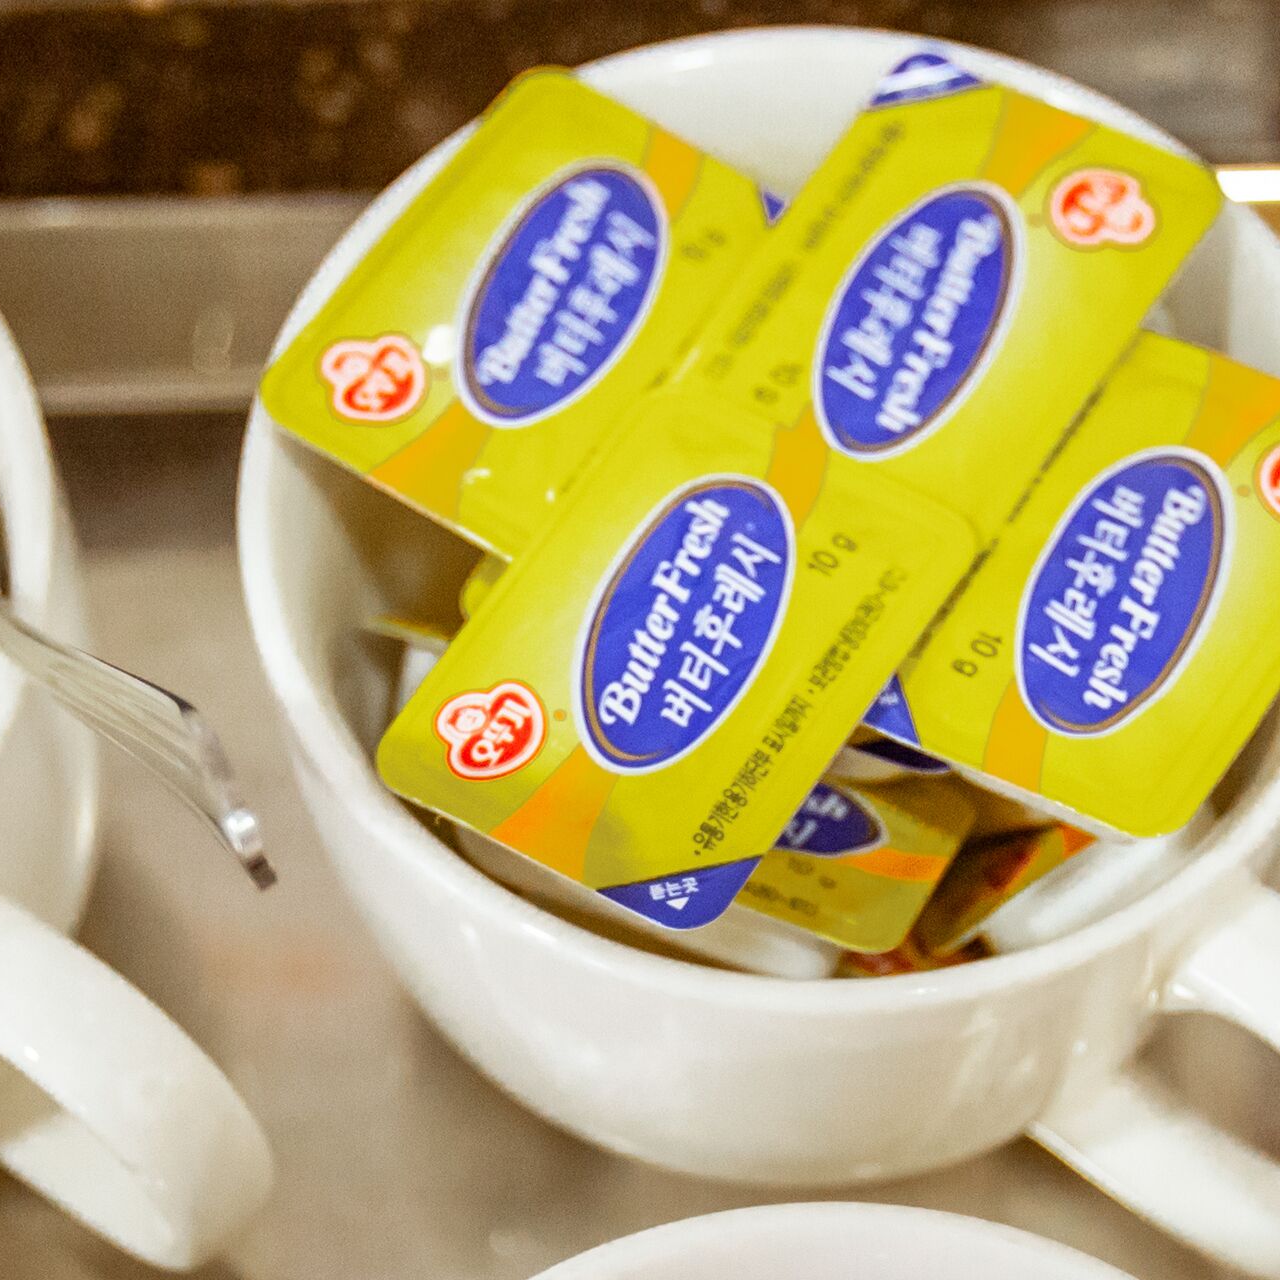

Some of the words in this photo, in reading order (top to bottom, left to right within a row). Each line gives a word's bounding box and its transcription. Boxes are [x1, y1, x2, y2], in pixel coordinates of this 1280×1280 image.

[536, 208, 656, 387] 버터후레시
[825, 221, 943, 401] 버터후레시
[806, 549, 840, 578] 10
[1027, 485, 1146, 680] 버터후레시
[659, 532, 782, 729] 버터후레시
[952, 657, 979, 678] g
[971, 630, 1004, 659] 10
[470, 699, 532, 768] 오뚜기
